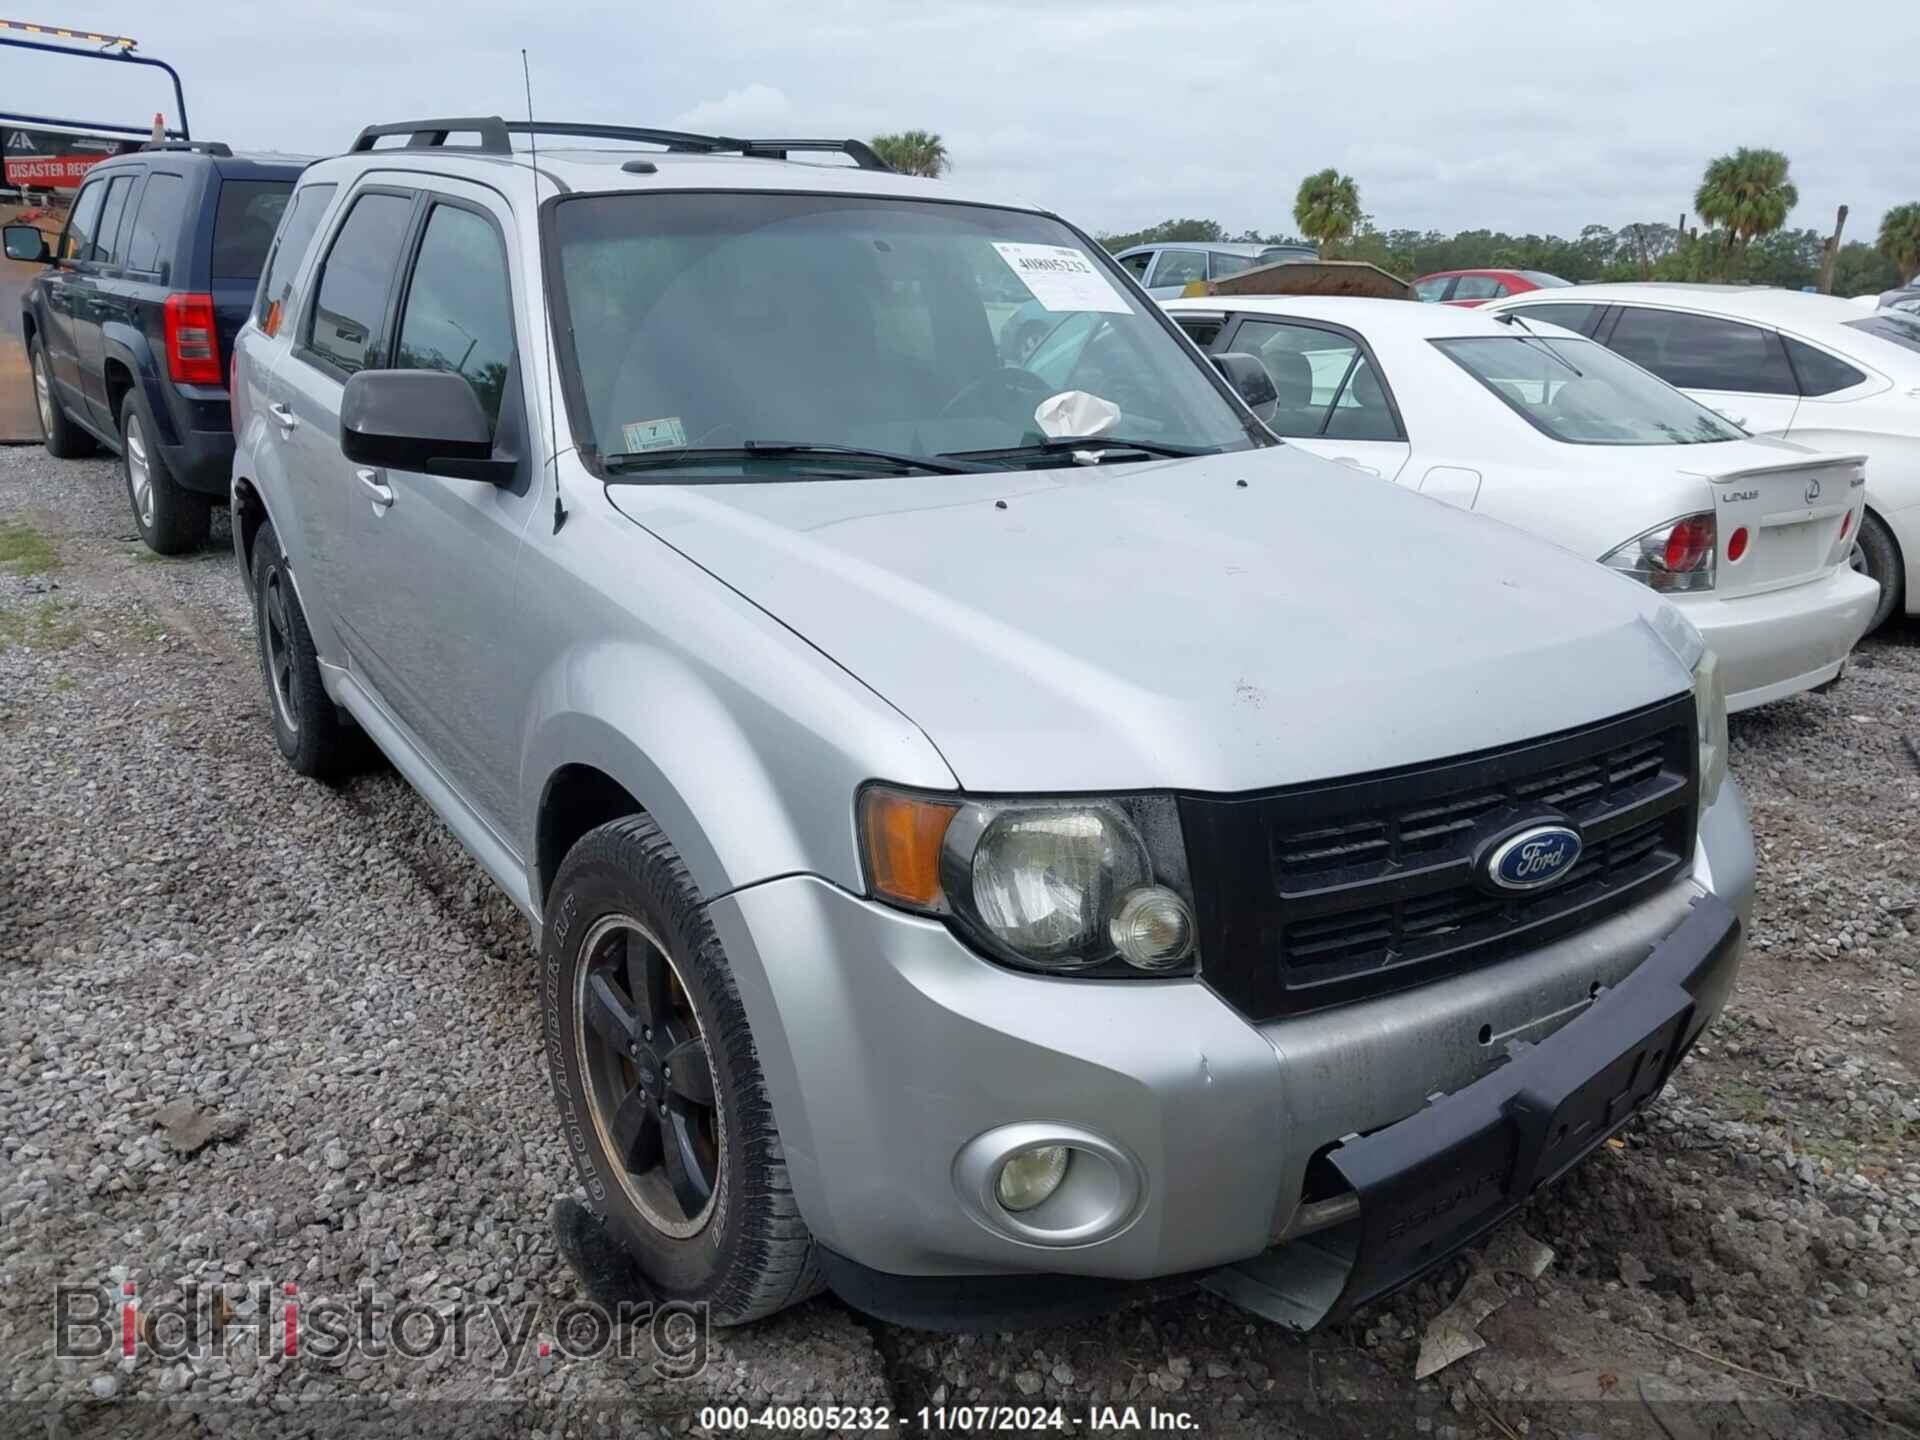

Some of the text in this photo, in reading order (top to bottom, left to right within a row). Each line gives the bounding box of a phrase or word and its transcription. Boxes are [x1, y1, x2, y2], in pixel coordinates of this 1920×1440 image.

[9, 163, 64, 177] DISASTER
[1018, 257, 1092, 274] 40805232
[647, 426, 658, 437] 7
[1516, 839, 1565, 877] Ford
[547, 893, 606, 1200] GEOLANDAR A/T
